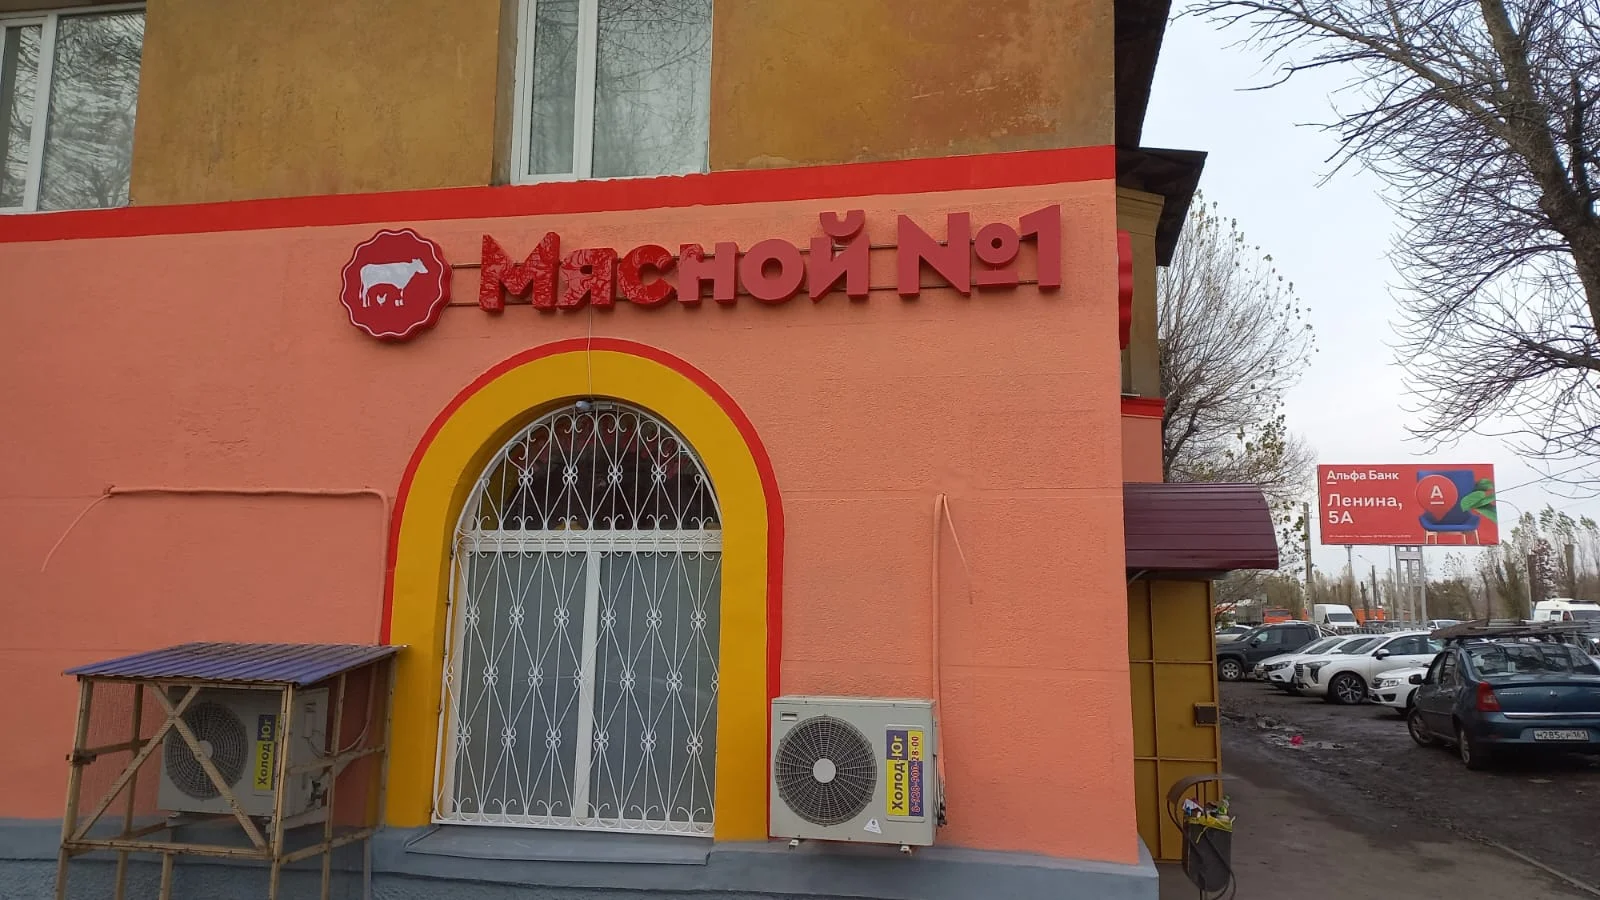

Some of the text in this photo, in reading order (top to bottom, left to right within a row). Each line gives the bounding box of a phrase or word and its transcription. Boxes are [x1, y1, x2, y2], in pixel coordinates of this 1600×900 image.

[479, 209, 870, 313] Мясной
[1326, 470, 1400, 483] Альфа Банк
[1327, 493, 1403, 510] Ленина,
[1328, 510, 1354, 524] 5А
[891, 735, 906, 810] Холод-Юг
